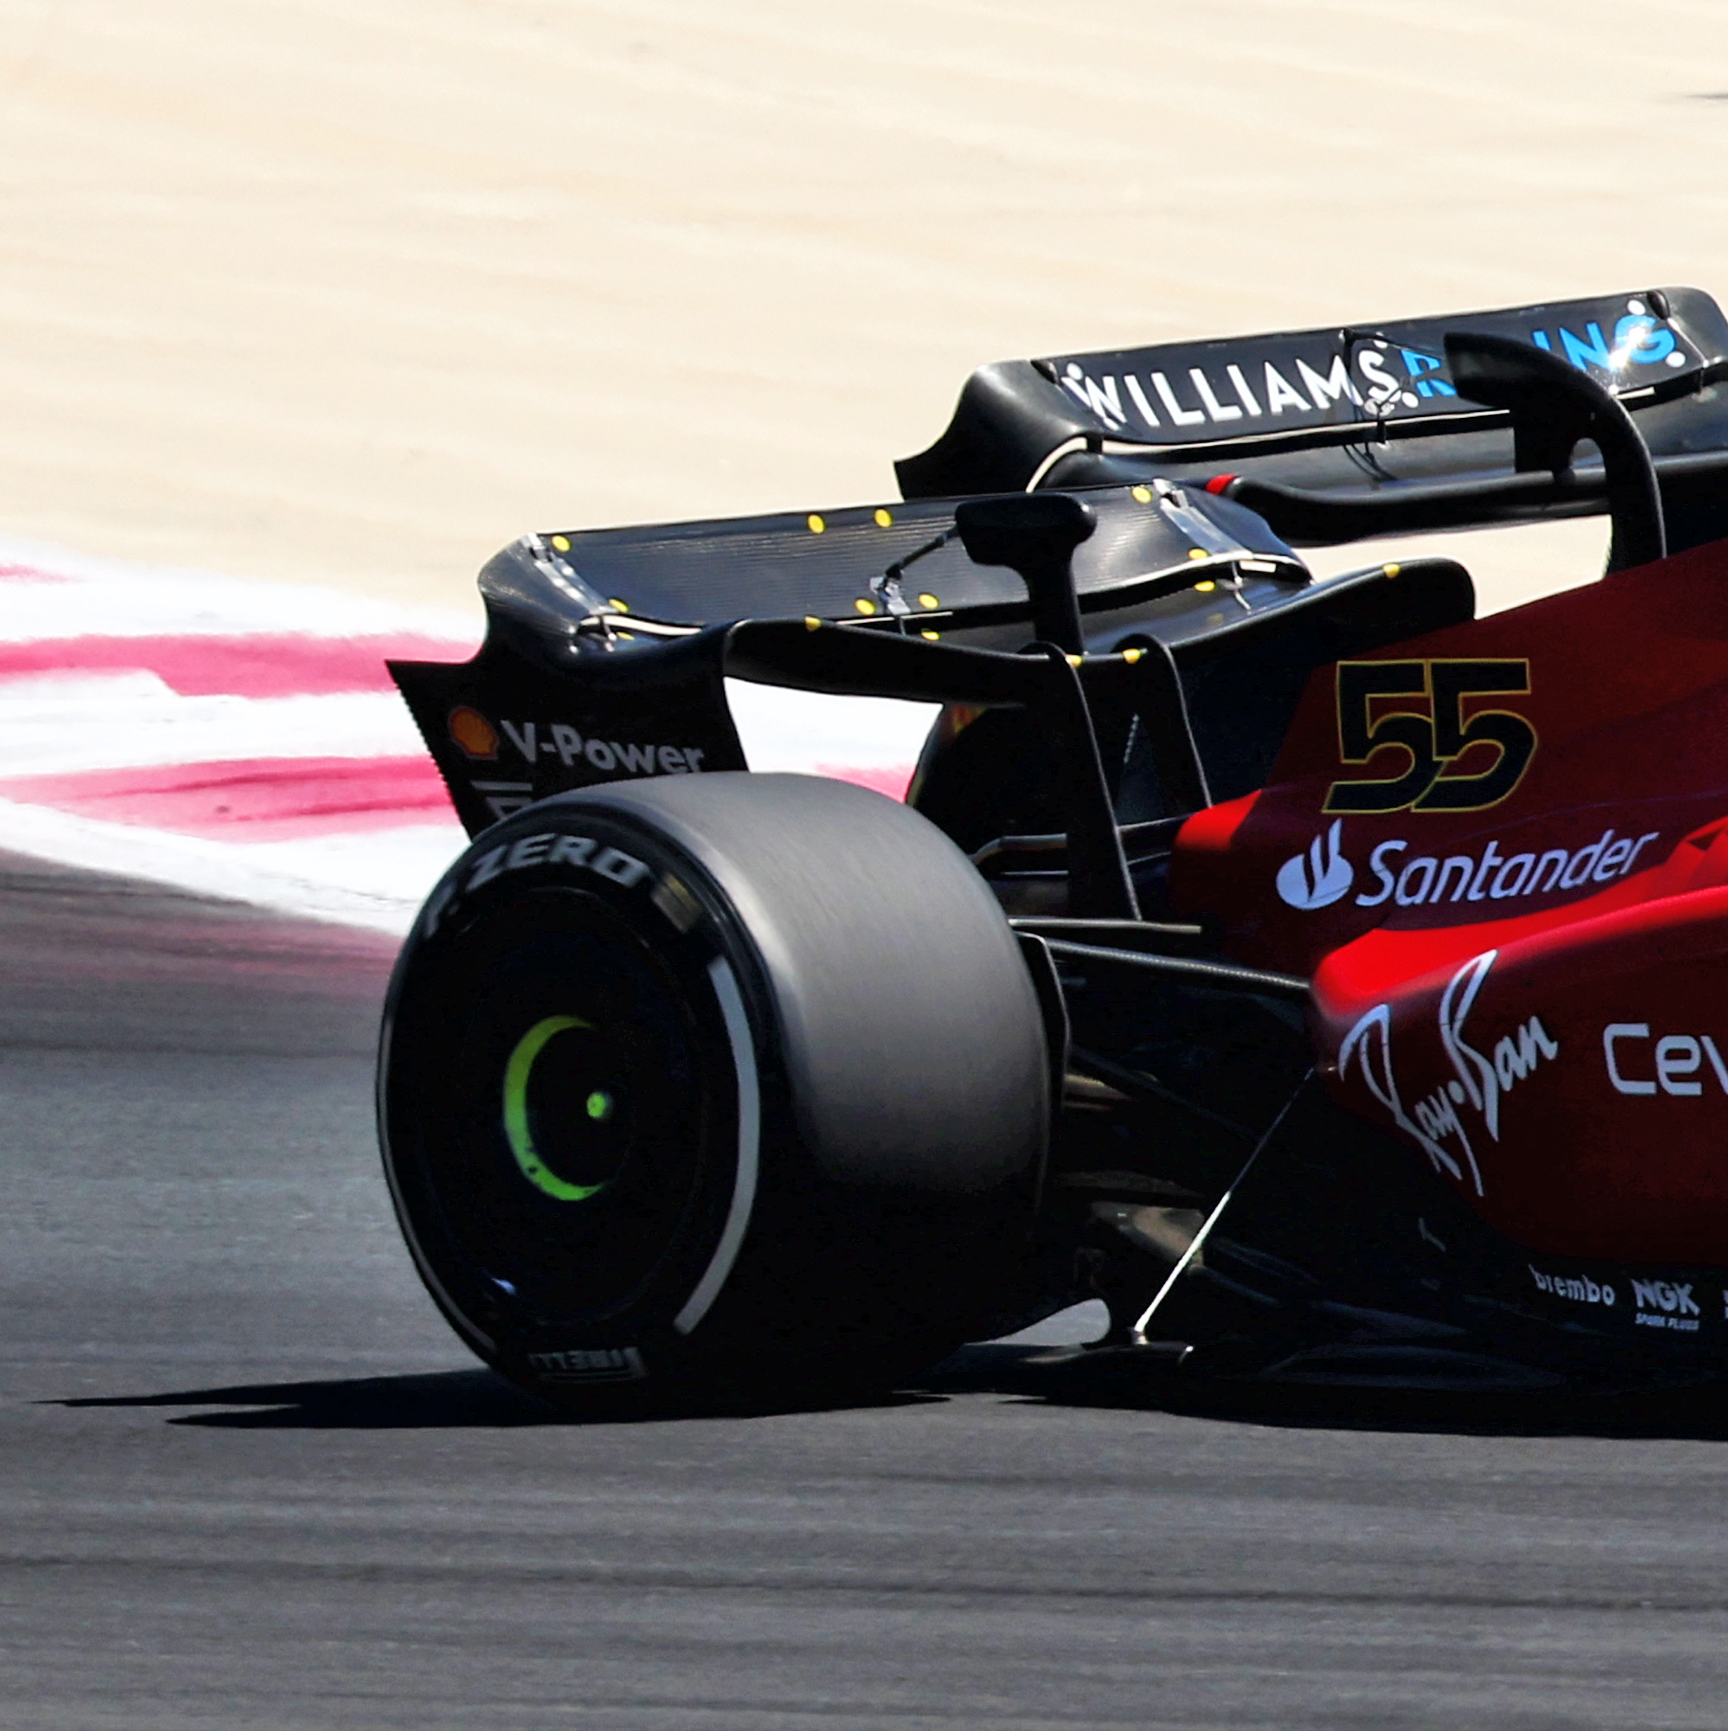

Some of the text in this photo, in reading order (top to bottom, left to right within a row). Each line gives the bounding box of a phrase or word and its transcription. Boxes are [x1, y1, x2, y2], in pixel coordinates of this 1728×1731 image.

[1064, 348, 1402, 431] WILLIAMS
[501, 720, 705, 773] V-Power
[1321, 658, 1538, 814] 55
[465, 833, 652, 892] ZERO
[1357, 830, 1660, 907] Santander
[1529, 1264, 1616, 1306] brembo
[1630, 1278, 1700, 1316] NGK
